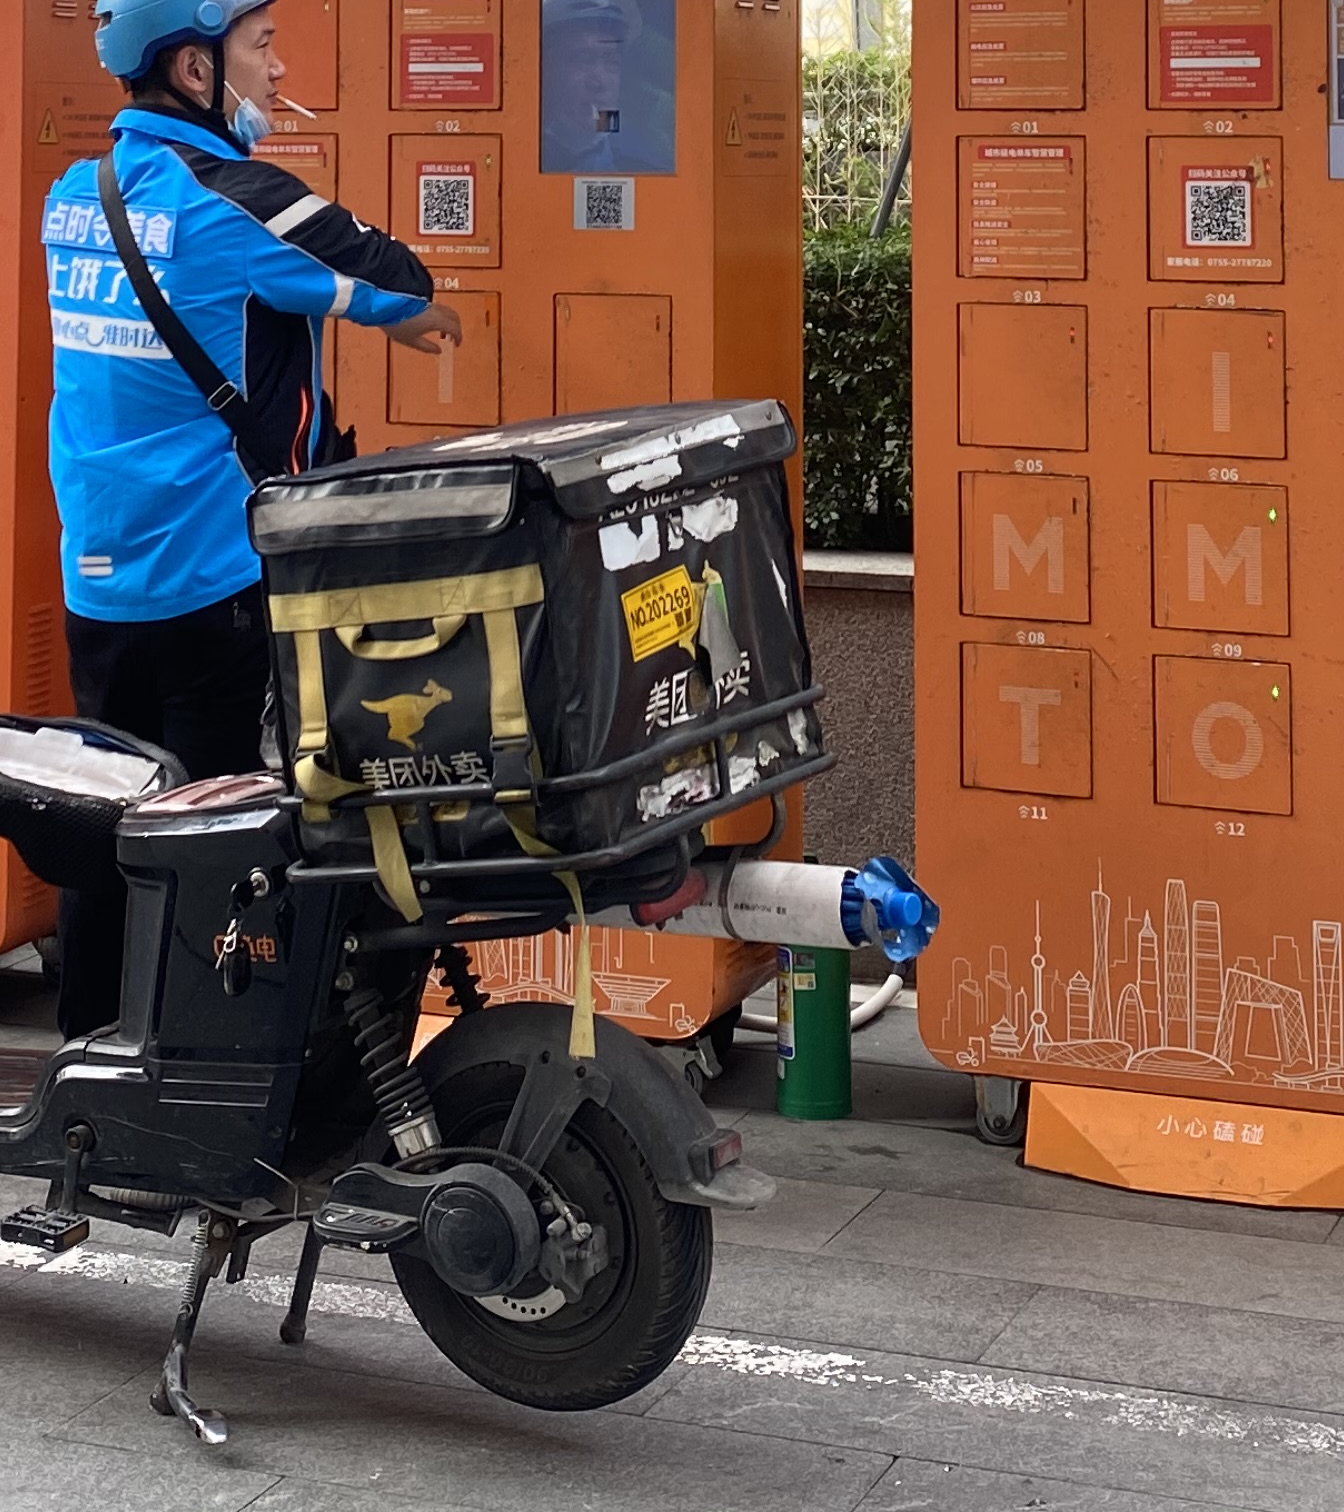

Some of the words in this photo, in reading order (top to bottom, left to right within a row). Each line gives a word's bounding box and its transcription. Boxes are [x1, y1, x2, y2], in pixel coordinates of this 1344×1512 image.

[284, 120, 298, 132] 01
[445, 120, 461, 132] 02
[1022, 121, 1039, 135] 01
[1215, 120, 1234, 134] 02
[444, 277, 460, 289] 04
[1024, 290, 1042, 304] 03
[1217, 293, 1236, 307] 04
[1026, 459, 1043, 473] 05
[1220, 467, 1239, 482] 06
[992, 513, 1064, 594] M
[1187, 524, 1262, 605] M
[630, 585, 692, 631] NO.202269
[1027, 631, 1046, 645] 08
[1223, 643, 1242, 658] 09
[998, 686, 1061, 765] T
[1191, 701, 1263, 780] O
[359, 750, 492, 790] 美团外卖
[1030, 805, 1049, 820] 11
[1227, 822, 1246, 836] 12
[1157, 1113, 1265, 1149] 小心磕碰
